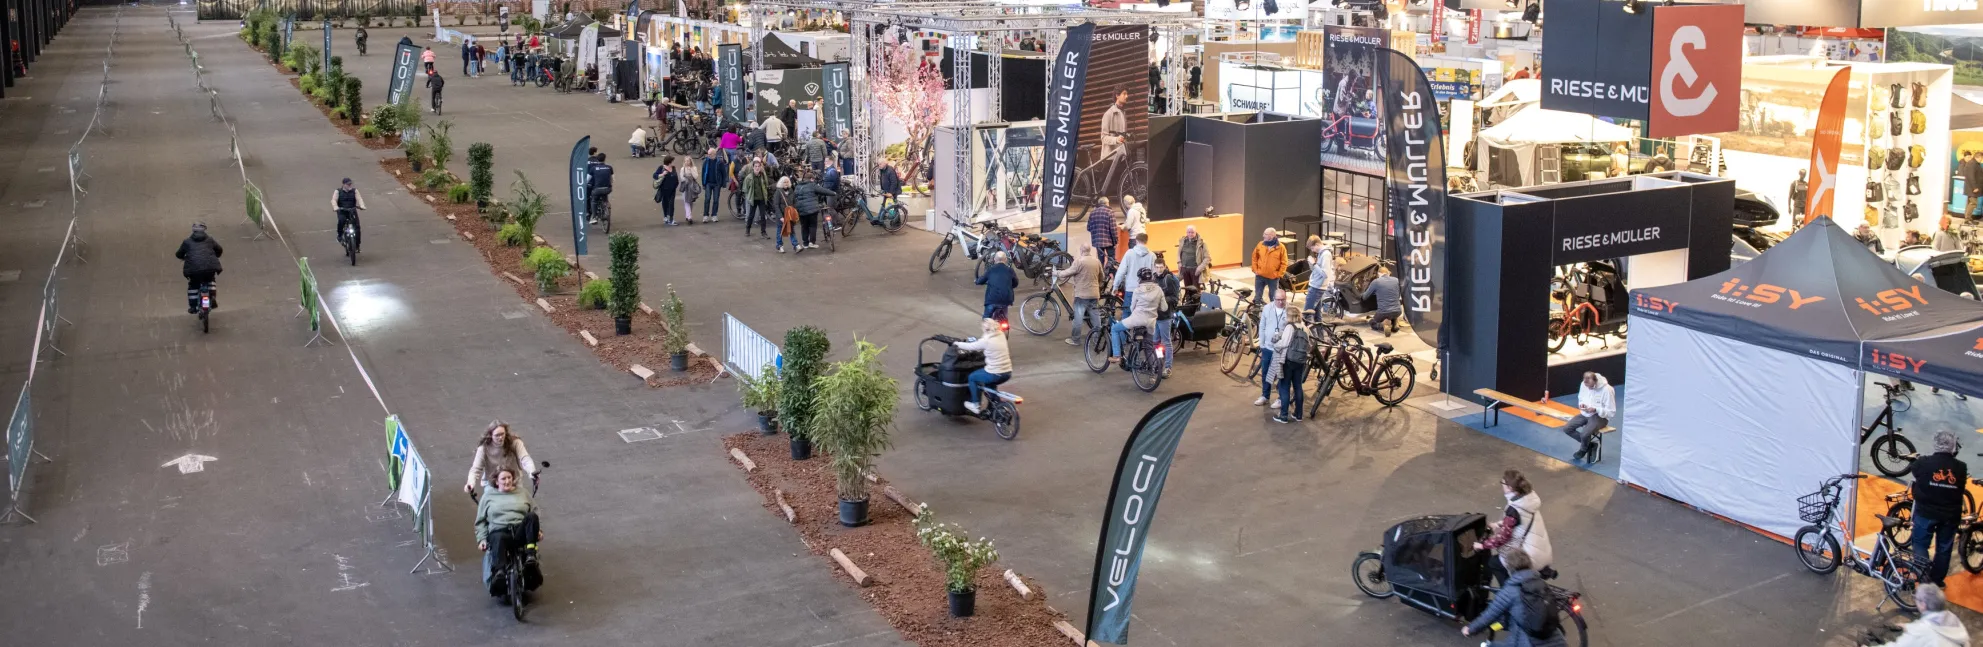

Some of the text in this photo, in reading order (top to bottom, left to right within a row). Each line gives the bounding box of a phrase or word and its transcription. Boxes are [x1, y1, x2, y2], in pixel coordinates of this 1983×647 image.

[1108, 32, 1140, 41] MÜLLER
[1330, 34, 1349, 43] RIESE
[392, 48, 411, 105] ELOCI
[1551, 78, 1605, 99] RIESE
[1608, 85, 1618, 99] &
[1053, 51, 1079, 208] RIESE & MÜLLER
[1563, 227, 1660, 251] RIESE & MÜLLER
[1636, 294, 1679, 314] i:SY
[1718, 277, 1826, 310] i:SY
[1855, 285, 1929, 316] i:SY
[1872, 349, 1927, 374] i:SY
[1103, 454, 1158, 612] VELOCI
